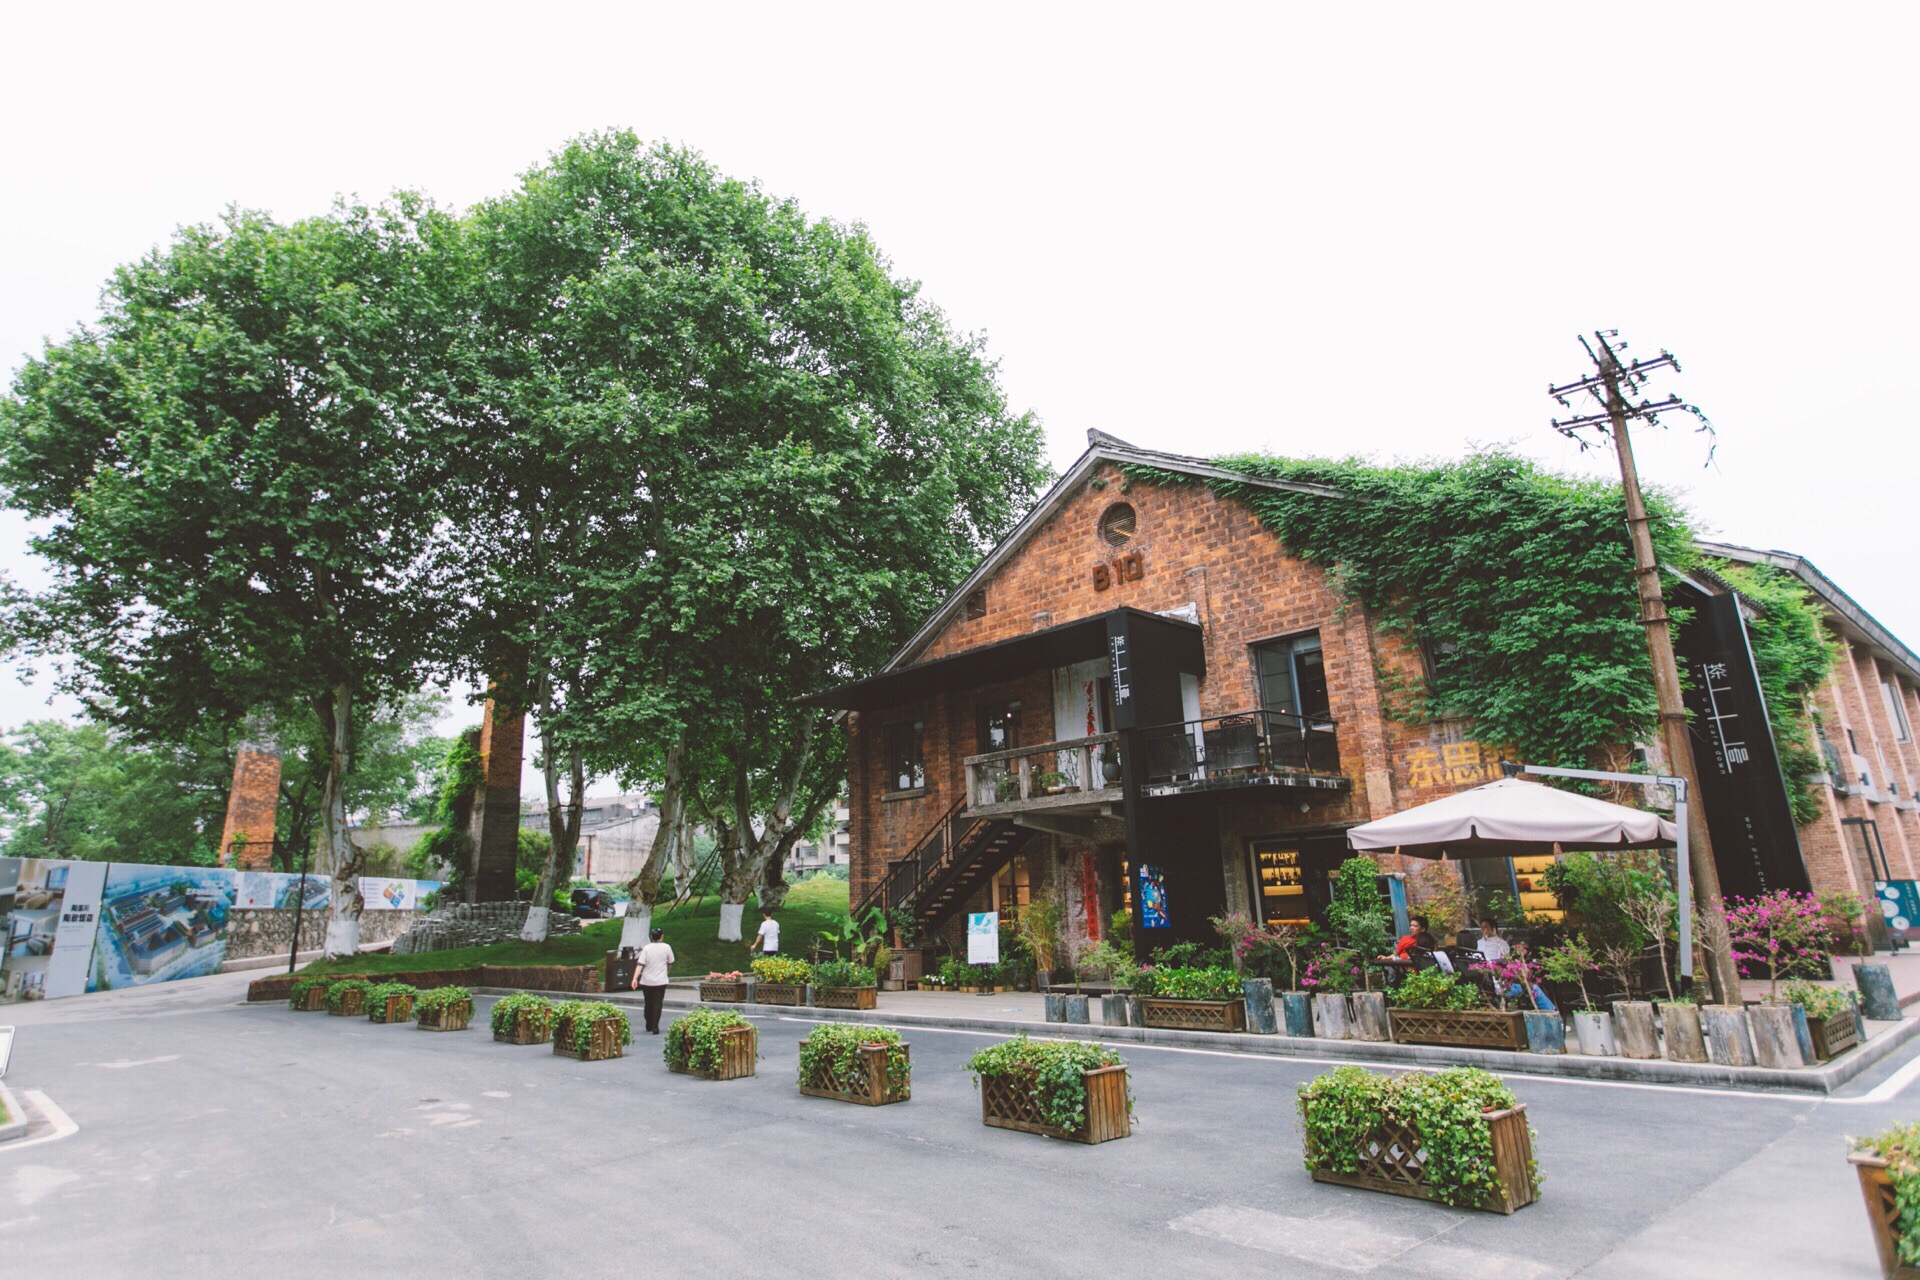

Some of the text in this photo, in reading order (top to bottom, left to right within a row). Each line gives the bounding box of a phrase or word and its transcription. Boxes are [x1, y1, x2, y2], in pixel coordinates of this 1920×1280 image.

[1093, 553, 1143, 591] B10
[1694, 664, 1726, 775] tea up cafe down
